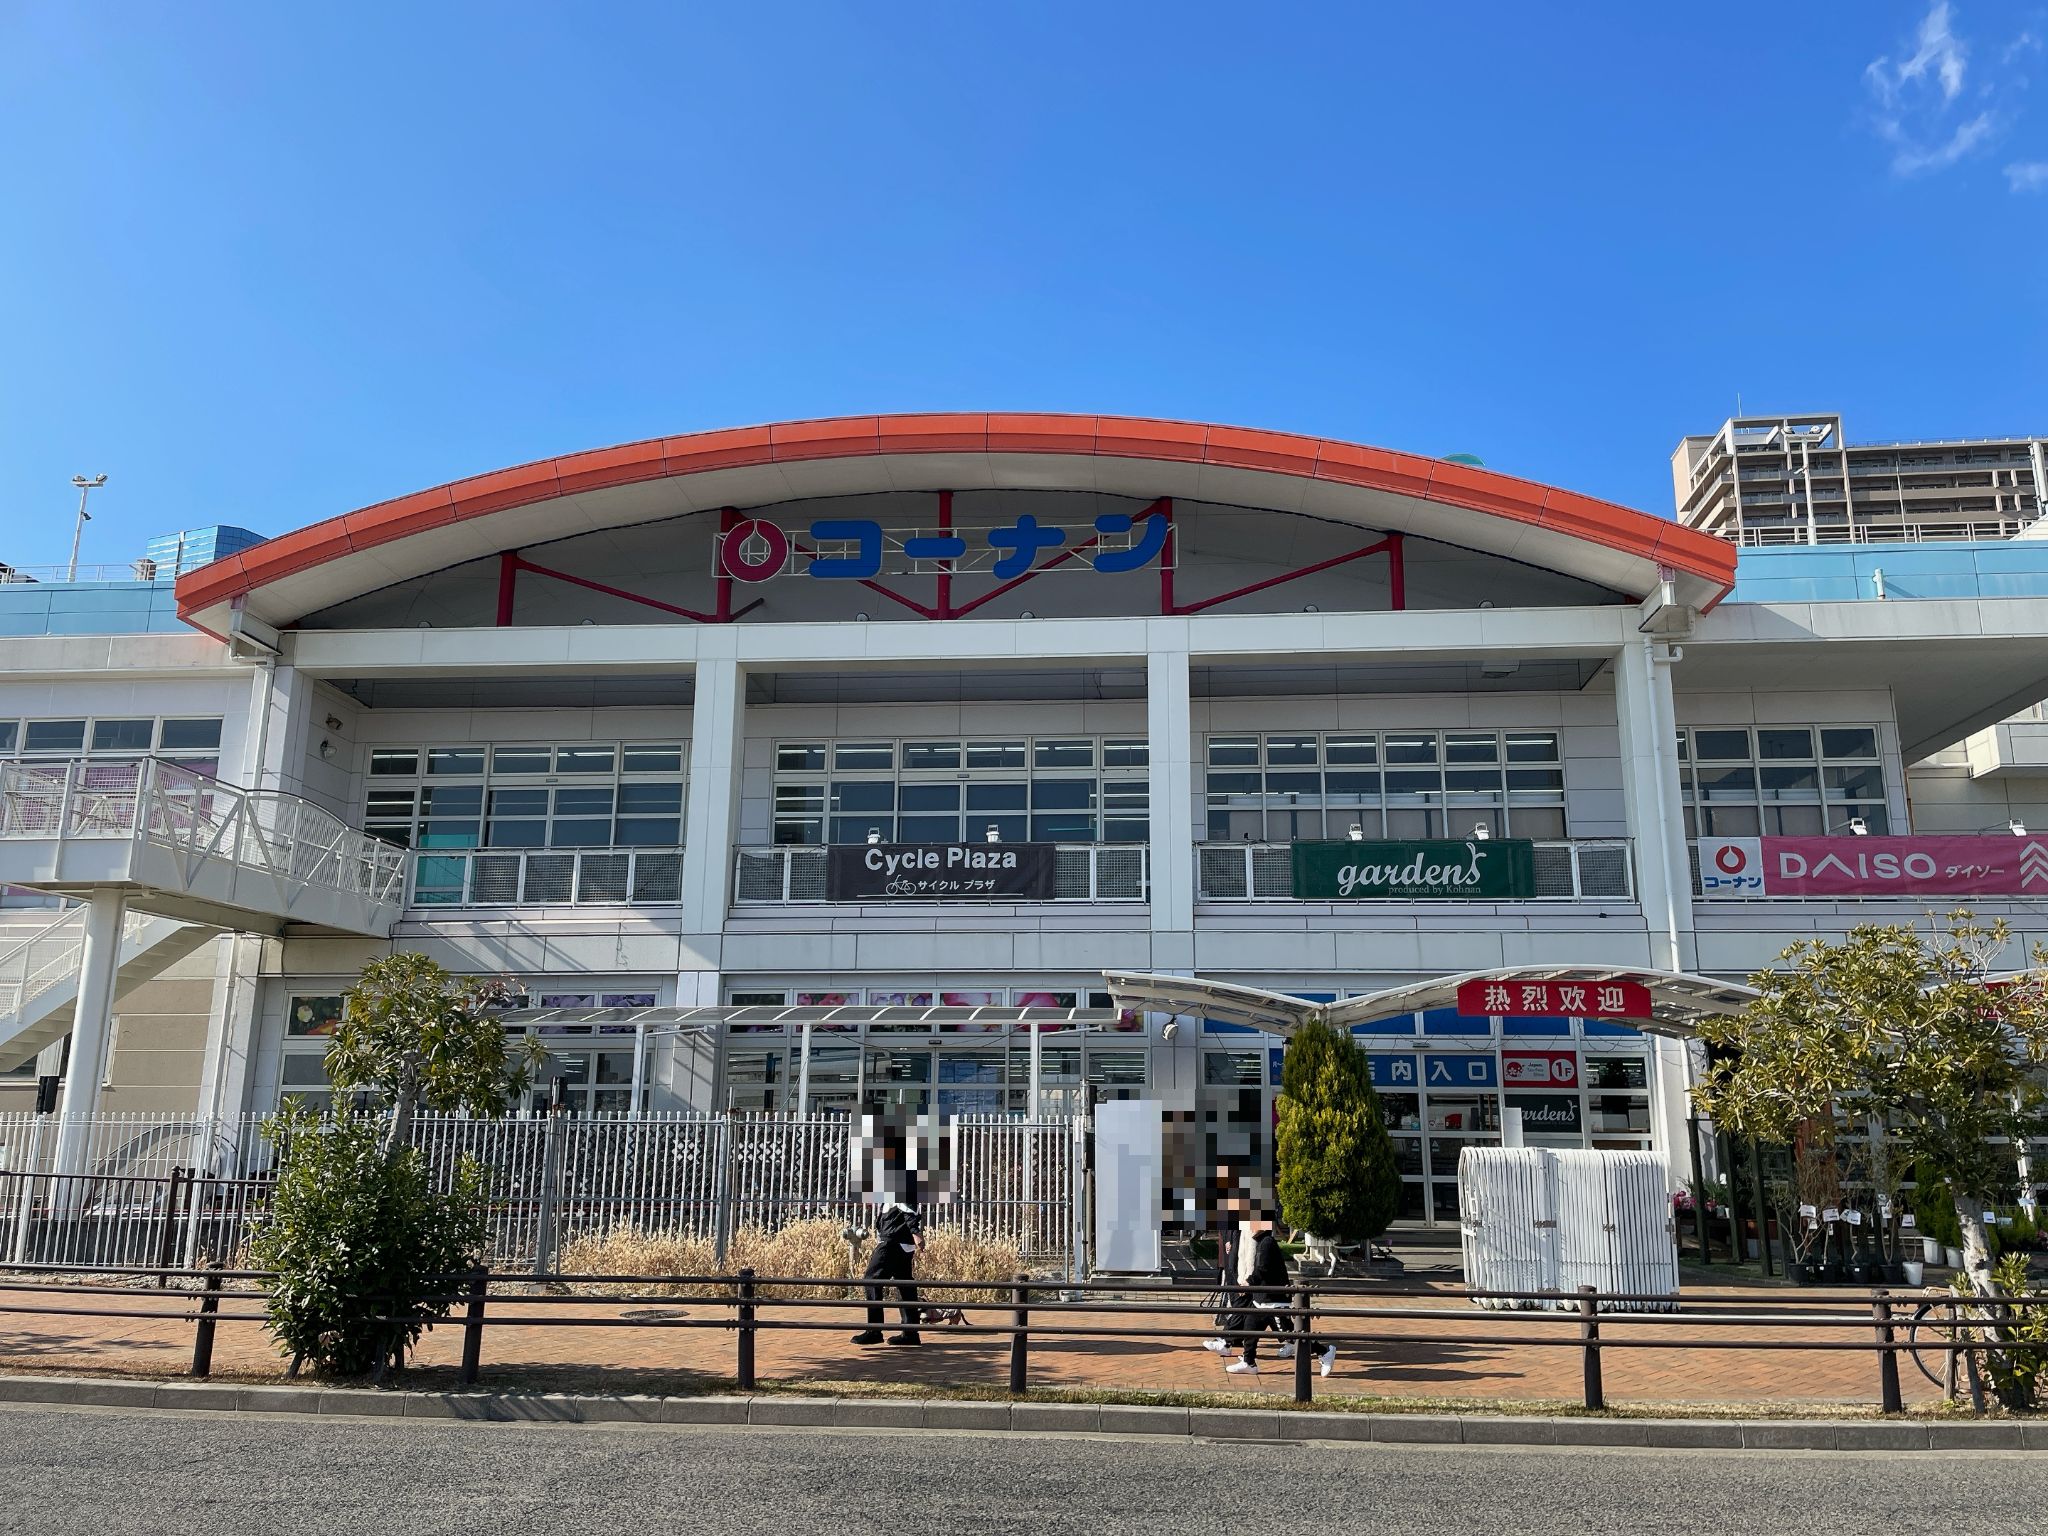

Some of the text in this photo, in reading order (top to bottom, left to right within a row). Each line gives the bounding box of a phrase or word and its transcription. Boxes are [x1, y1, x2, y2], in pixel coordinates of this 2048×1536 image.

[808, 514, 1168, 580] コーナン
[865, 848, 1017, 875] Cycle Plaza
[1337, 842, 1487, 896] gardens
[1779, 852, 1936, 879] DAISO
[1945, 865, 2005, 879] ダイソー
[918, 879, 996, 891] サイクル プラザ
[1388, 885, 1481, 896] produced by Kohnan
[1704, 876, 1762, 889] コーナン
[1485, 985, 1626, 1012] 热烈欢迎
[1555, 1061, 1572, 1077] 1F
[1521, 1099, 1578, 1122] ardens
